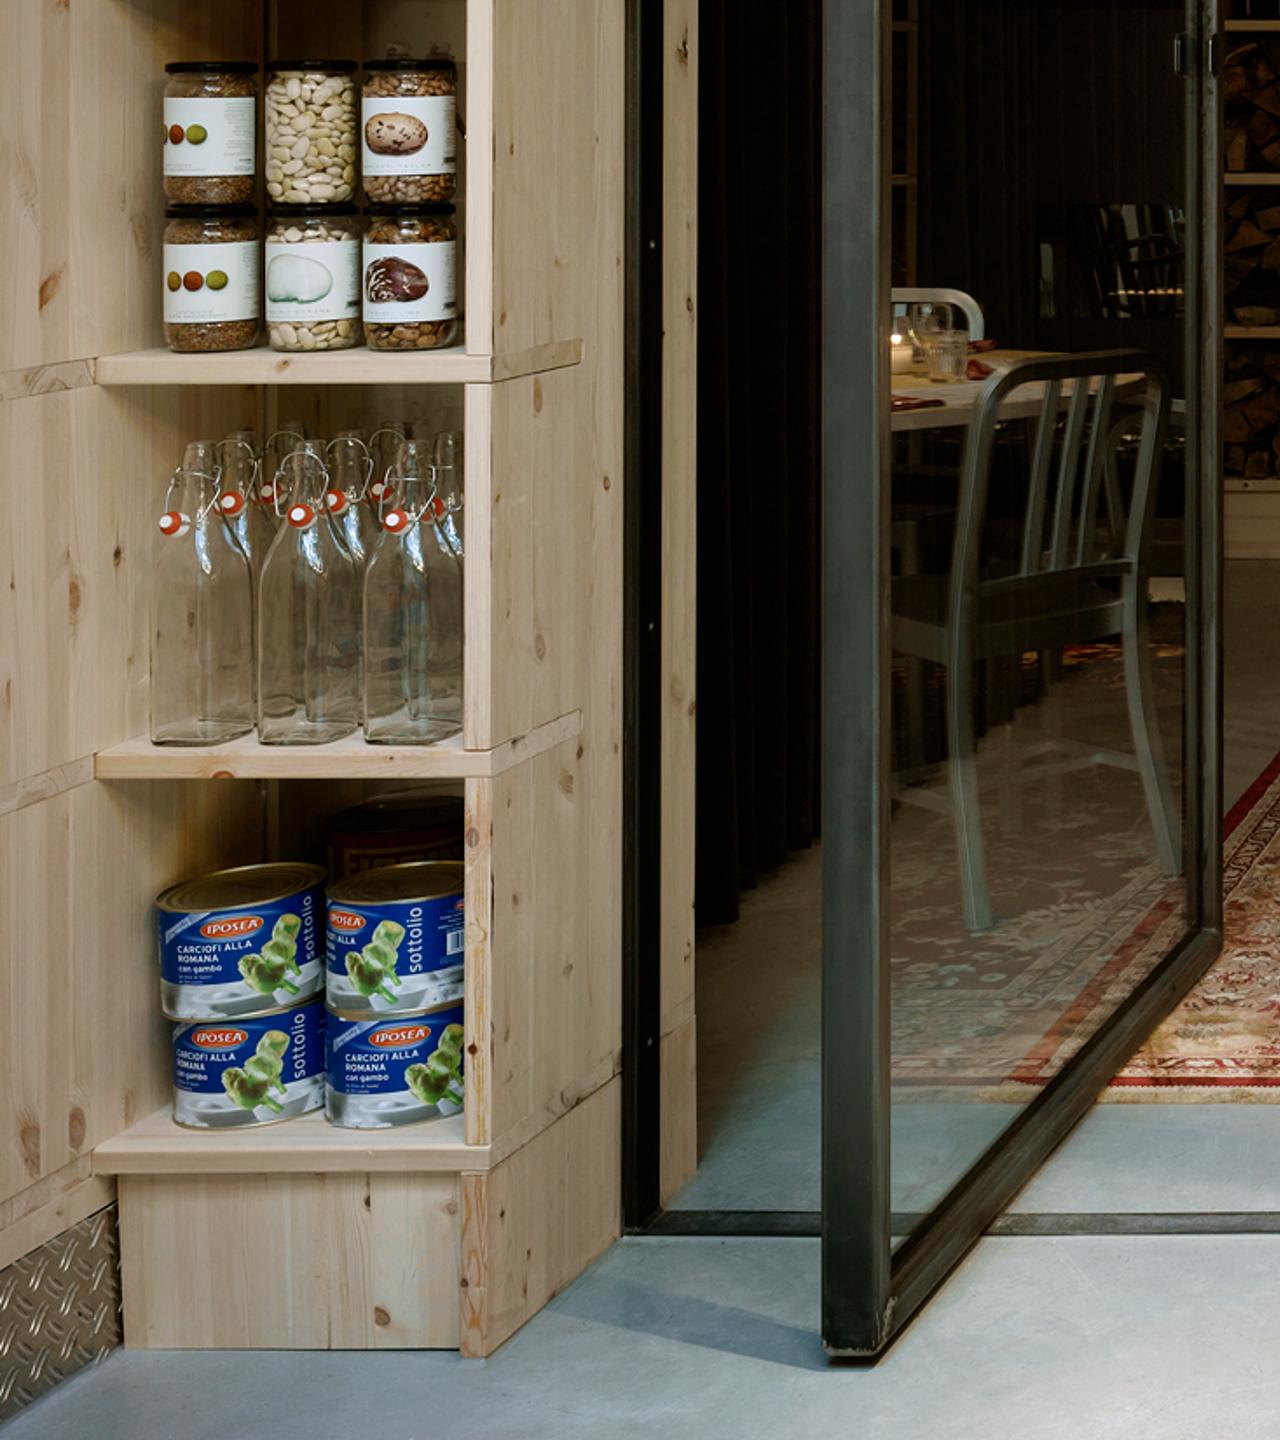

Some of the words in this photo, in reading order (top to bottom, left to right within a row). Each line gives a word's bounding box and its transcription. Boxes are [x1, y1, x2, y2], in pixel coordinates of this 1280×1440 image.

[331, 911, 362, 928] POSEA
[206, 919, 260, 936] IPOSEA
[176, 943, 221, 955] CARCIOFI
[223, 939, 253, 952] ALLA
[405, 906, 424, 974] sottolio
[177, 953, 219, 963] ROMANA
[177, 964, 193, 973] con
[193, 964, 223, 975] gambo
[195, 1031, 242, 1043] IPOSEA
[374, 1028, 426, 1044] IPOSEA
[290, 1013, 307, 1080] sottolio
[209, 1052, 236, 1063] ALLA
[344, 1053, 389, 1063] CARCIOFI
[390, 1048, 419, 1061] ALLA
[344, 1062, 386, 1073] ROMANA
[344, 1074, 359, 1082] con
[359, 1073, 390, 1084] gambo
